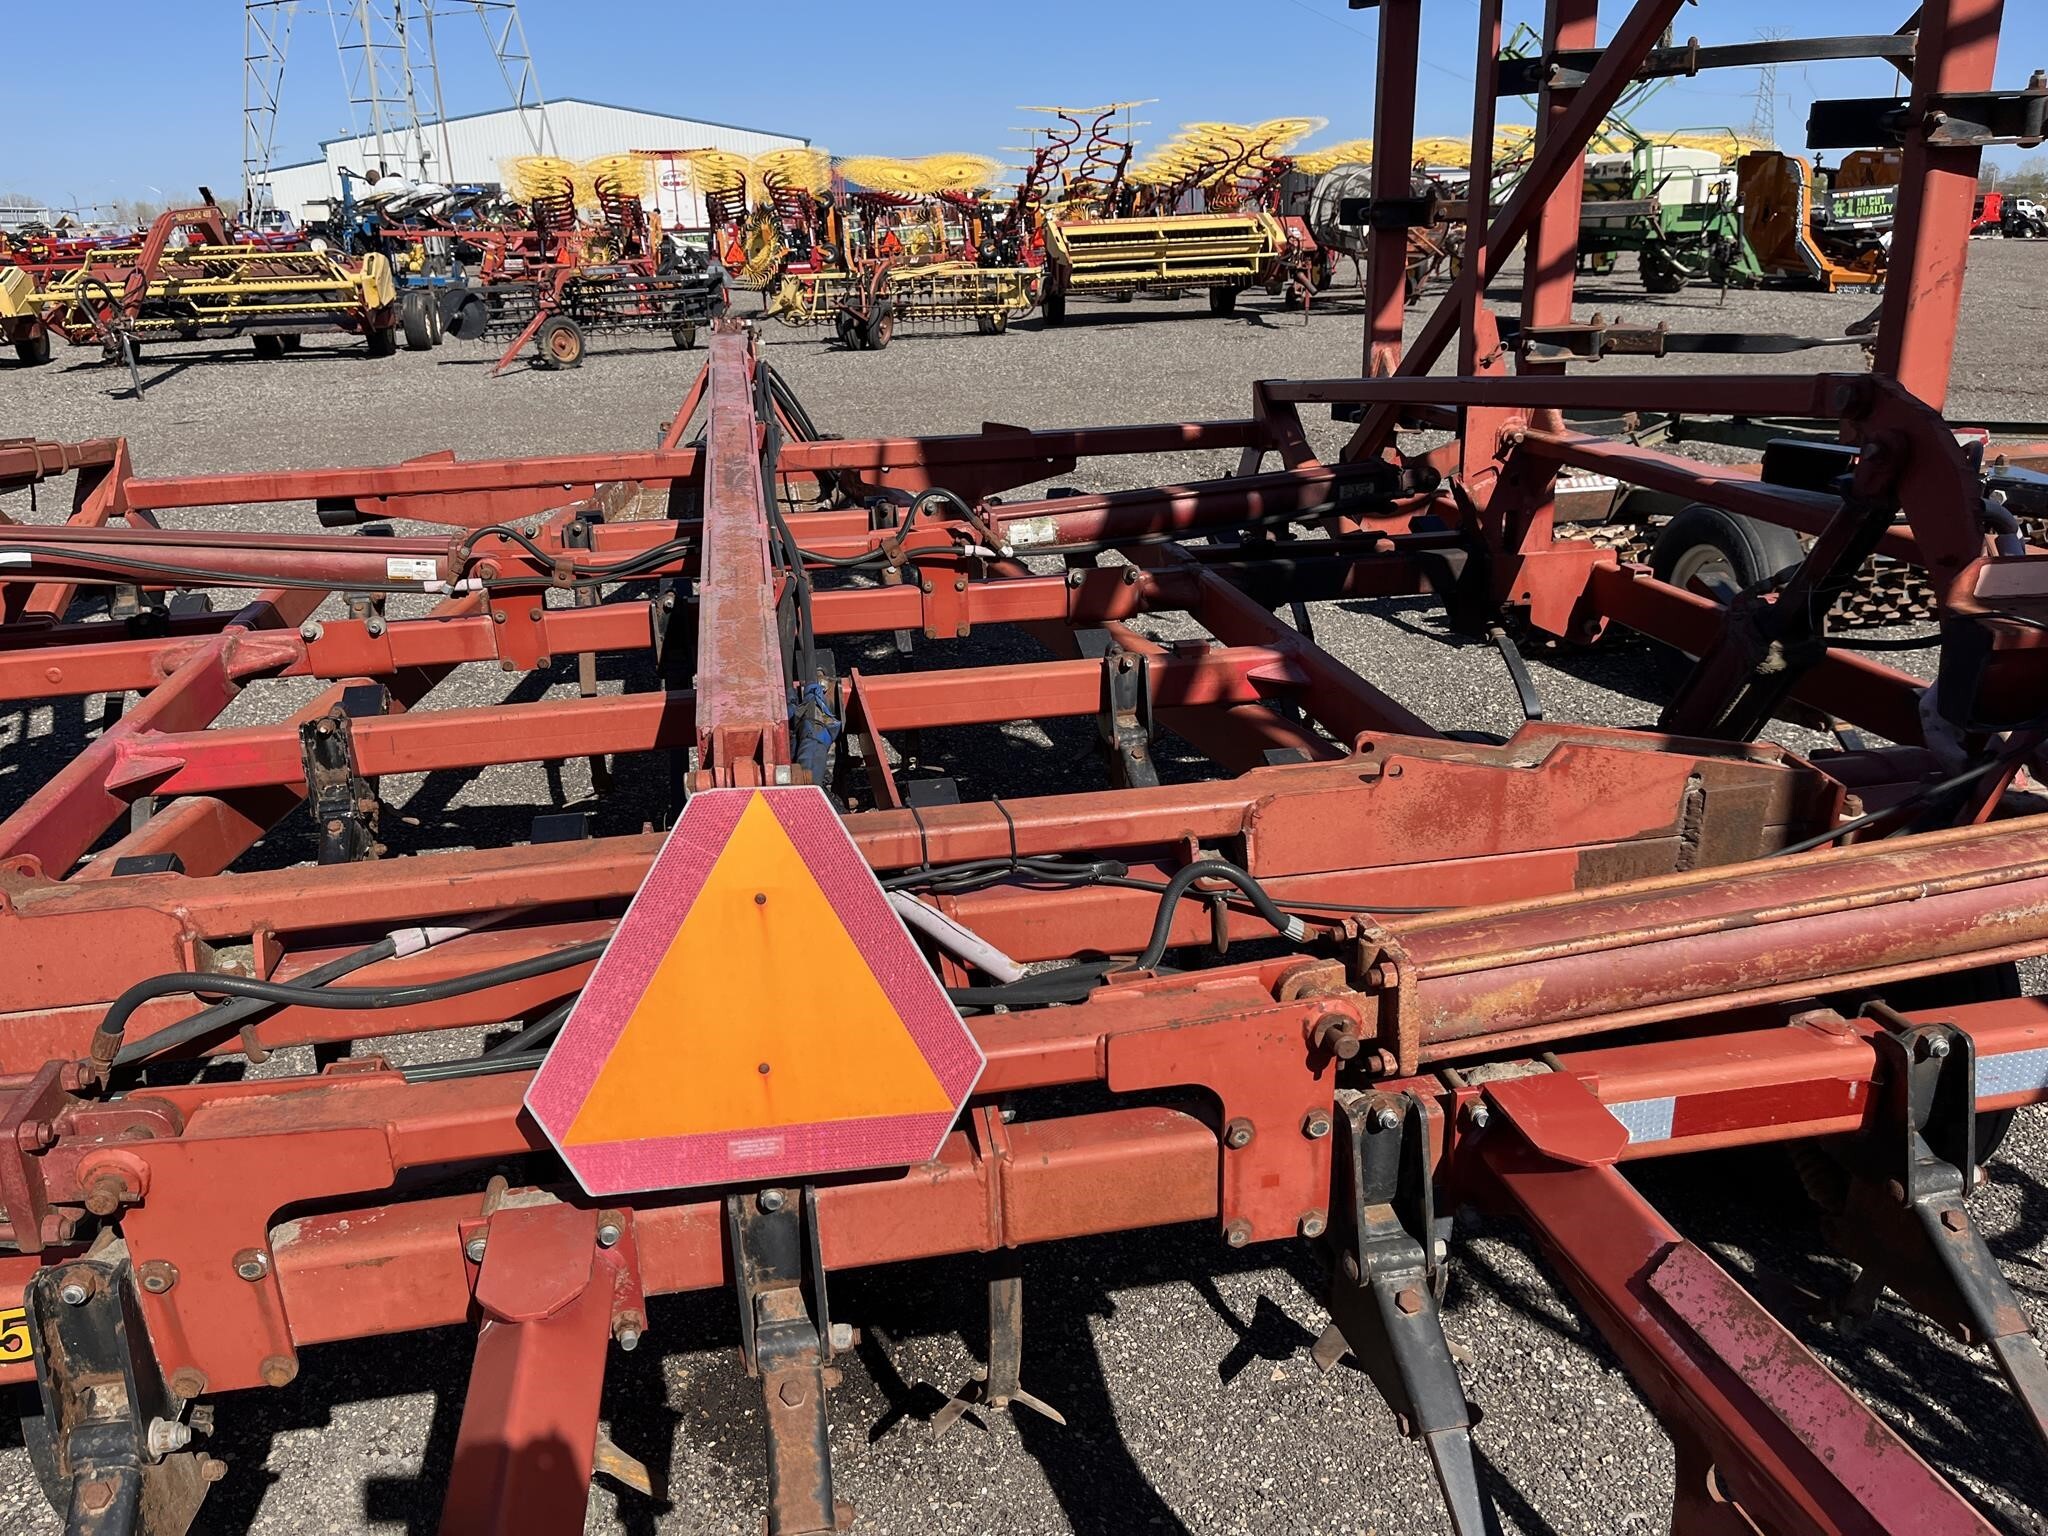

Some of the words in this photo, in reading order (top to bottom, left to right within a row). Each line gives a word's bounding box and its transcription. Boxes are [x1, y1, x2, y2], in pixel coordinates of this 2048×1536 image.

[1832, 199, 1855, 218] #1
[1857, 197, 1866, 206] IN
[1869, 195, 1885, 205] CUT
[1856, 204, 1893, 218] QUALITY
[0, 1307, 34, 1363] 5
